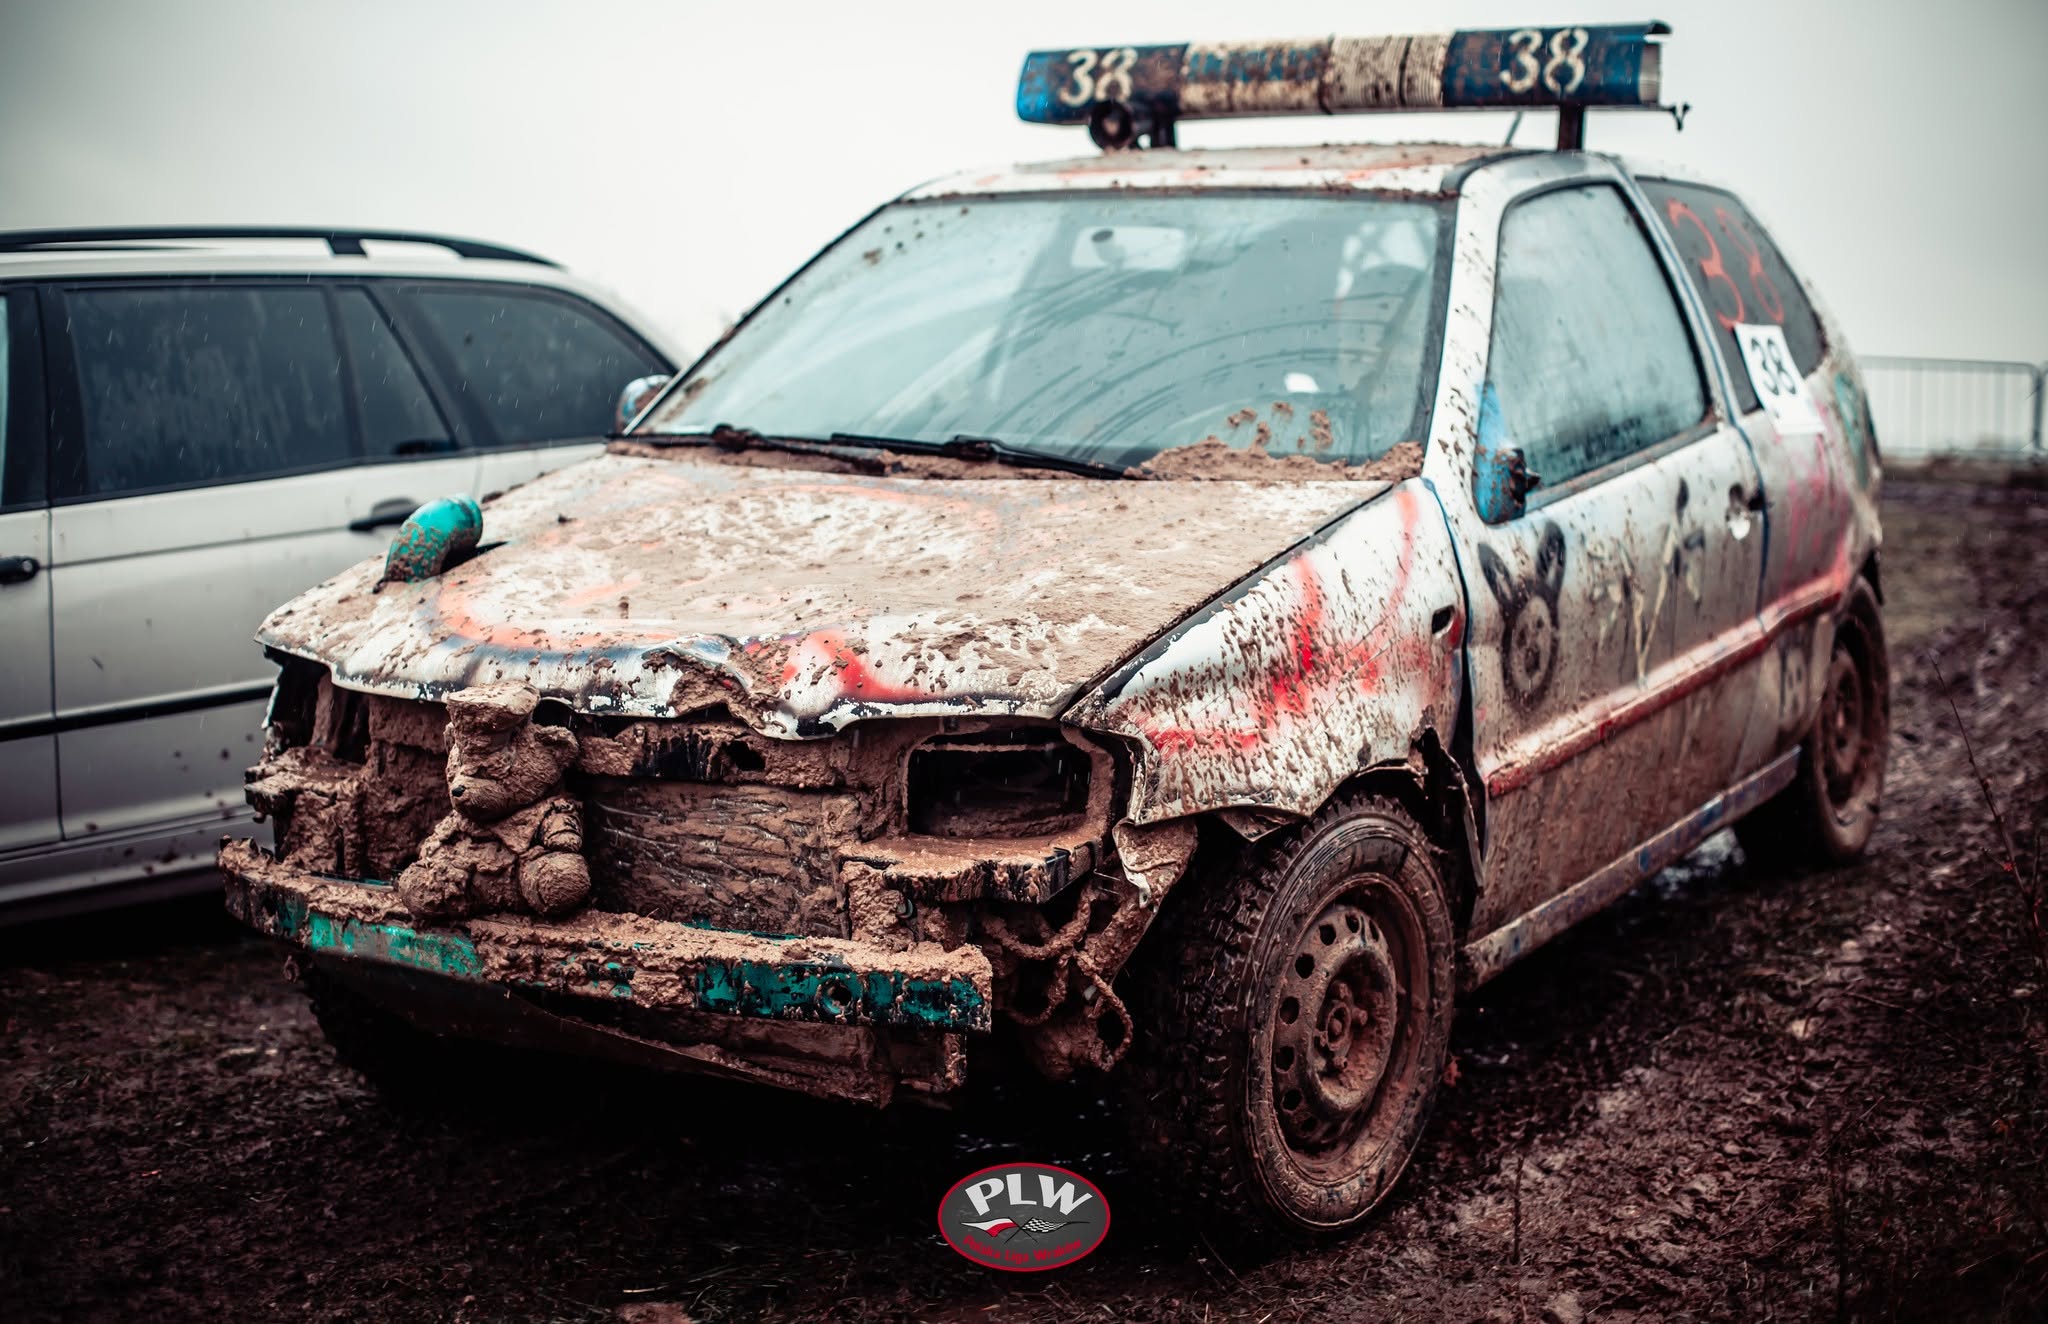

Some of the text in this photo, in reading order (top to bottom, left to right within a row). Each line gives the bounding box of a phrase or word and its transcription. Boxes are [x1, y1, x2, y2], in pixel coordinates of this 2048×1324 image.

[1060, 47, 1138, 107] 38
[1500, 27, 1588, 95] 38
[1667, 198, 1783, 330] 38
[1751, 336, 1797, 396] 38
